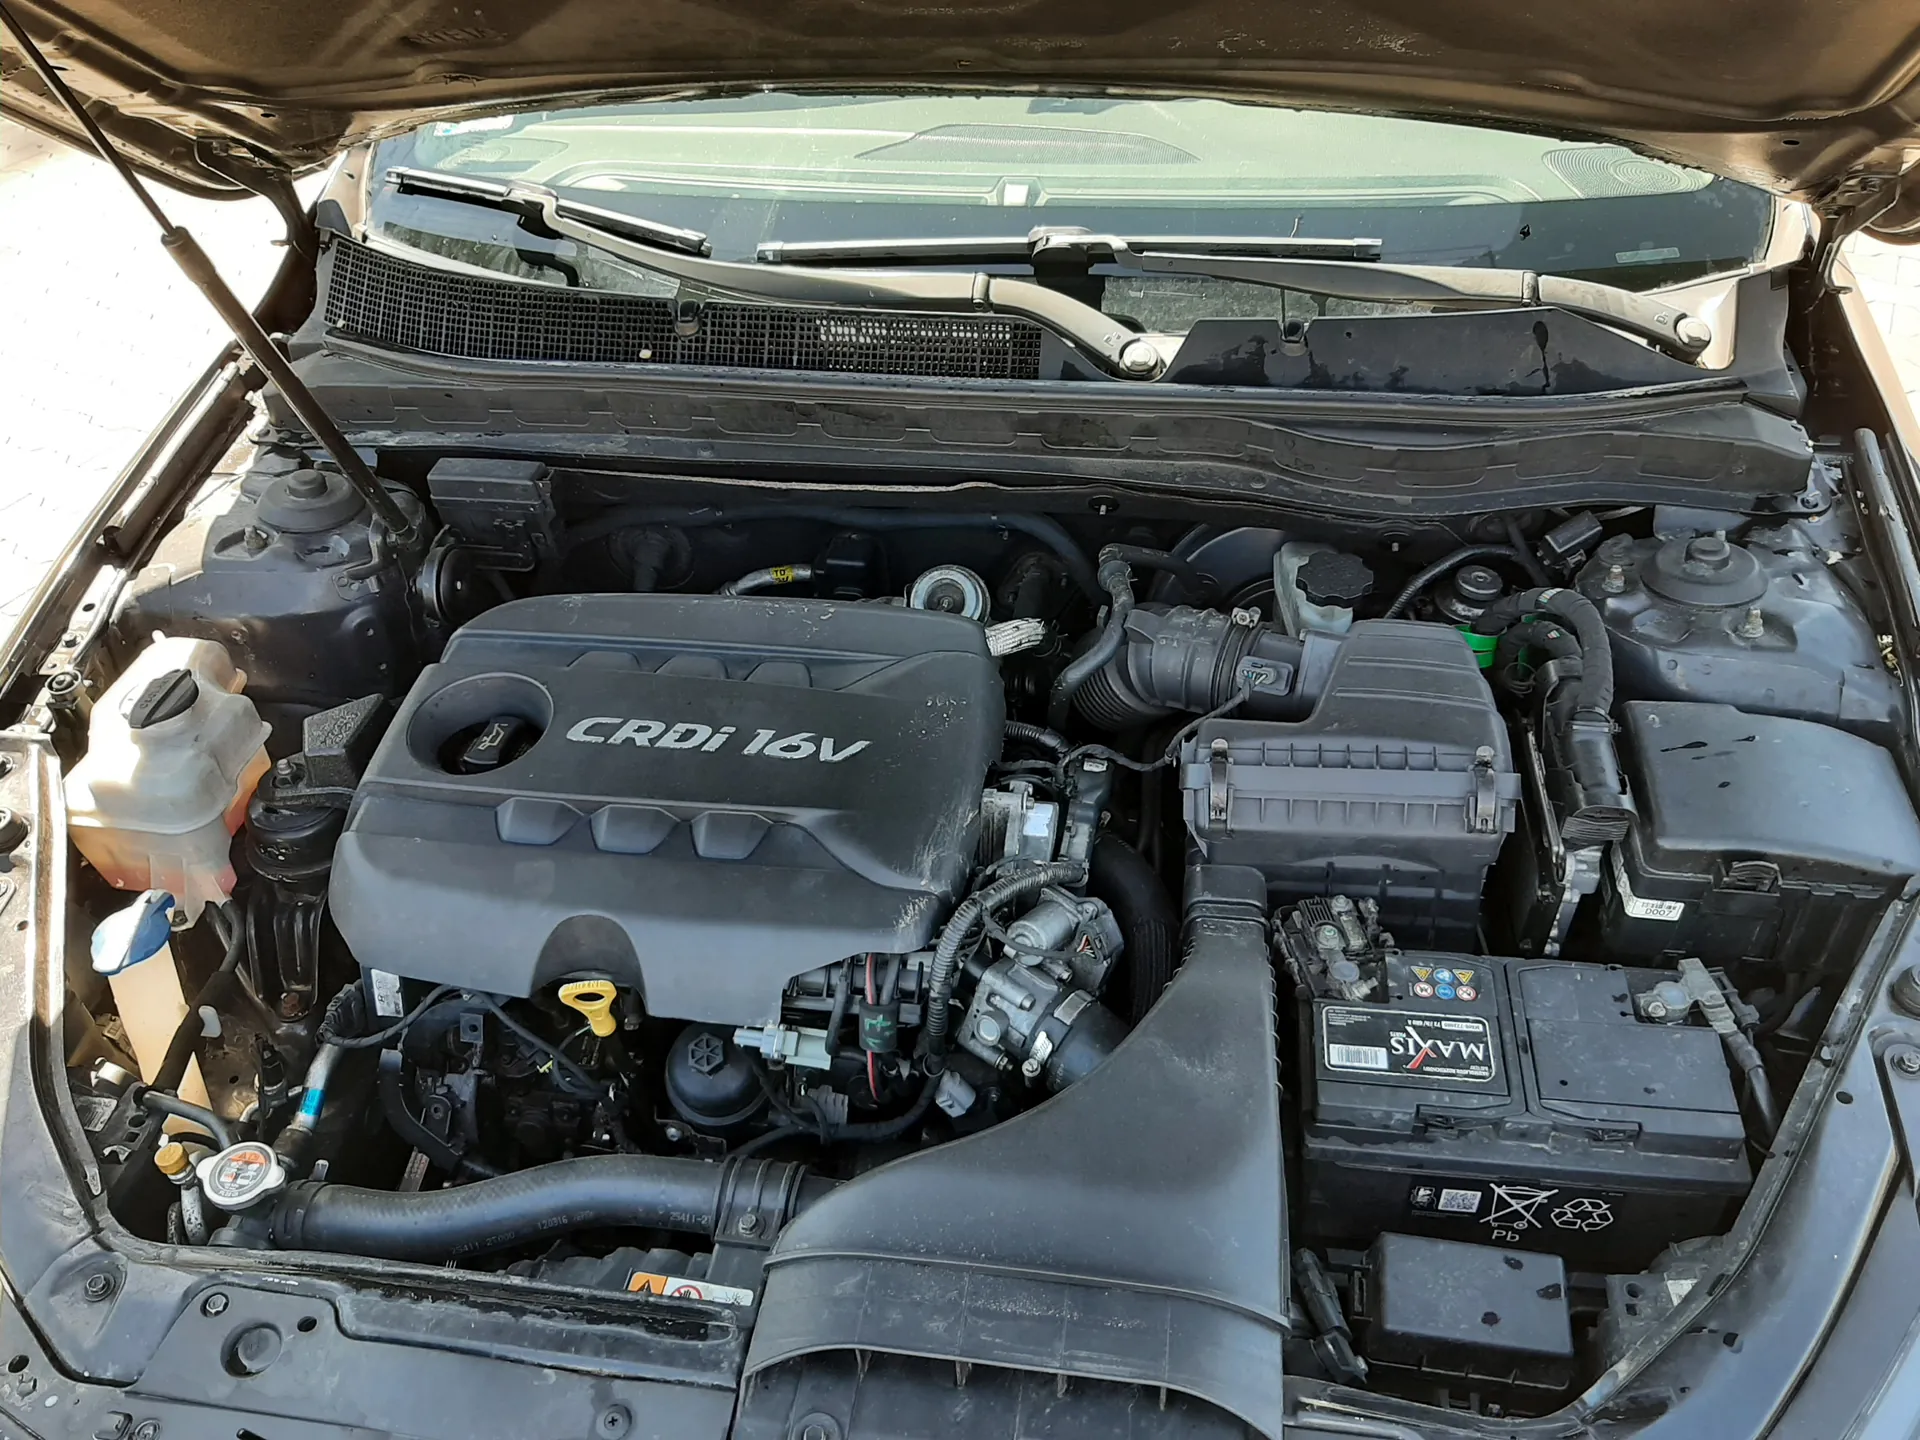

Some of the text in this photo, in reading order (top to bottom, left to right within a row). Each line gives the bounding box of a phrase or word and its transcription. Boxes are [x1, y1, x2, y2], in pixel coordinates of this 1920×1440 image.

[565, 716, 874, 763] CRDi 16V
[1389, 1026, 1485, 1069] MAXIS
[1491, 1228, 1520, 1243] Pb
